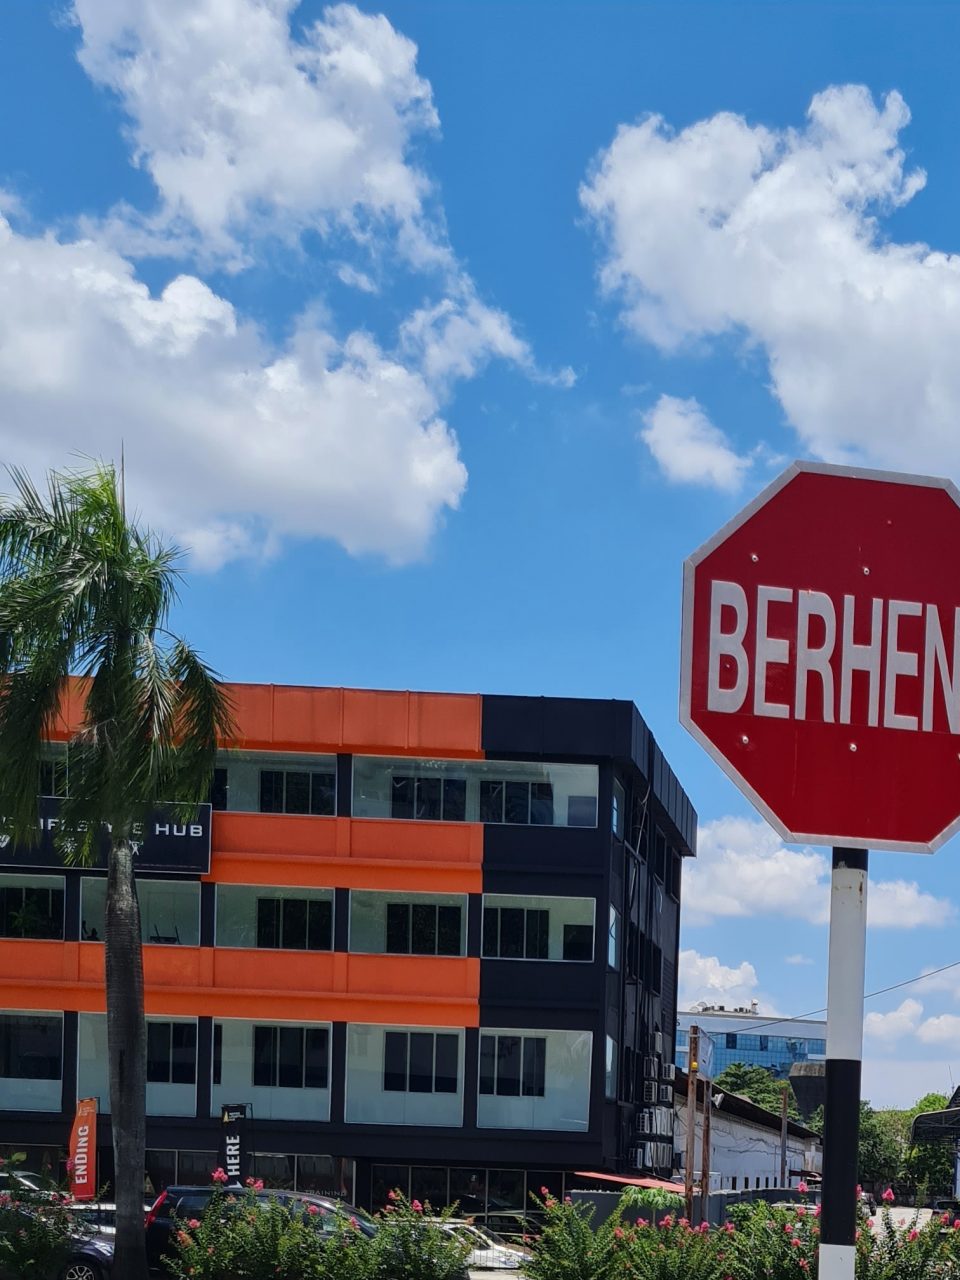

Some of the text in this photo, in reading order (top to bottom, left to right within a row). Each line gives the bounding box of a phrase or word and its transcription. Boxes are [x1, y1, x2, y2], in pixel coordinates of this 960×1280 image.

[155, 823, 203, 837] HUB
[75, 1125, 89, 1184] ENDING
[226, 1135, 240, 1176] HERE
